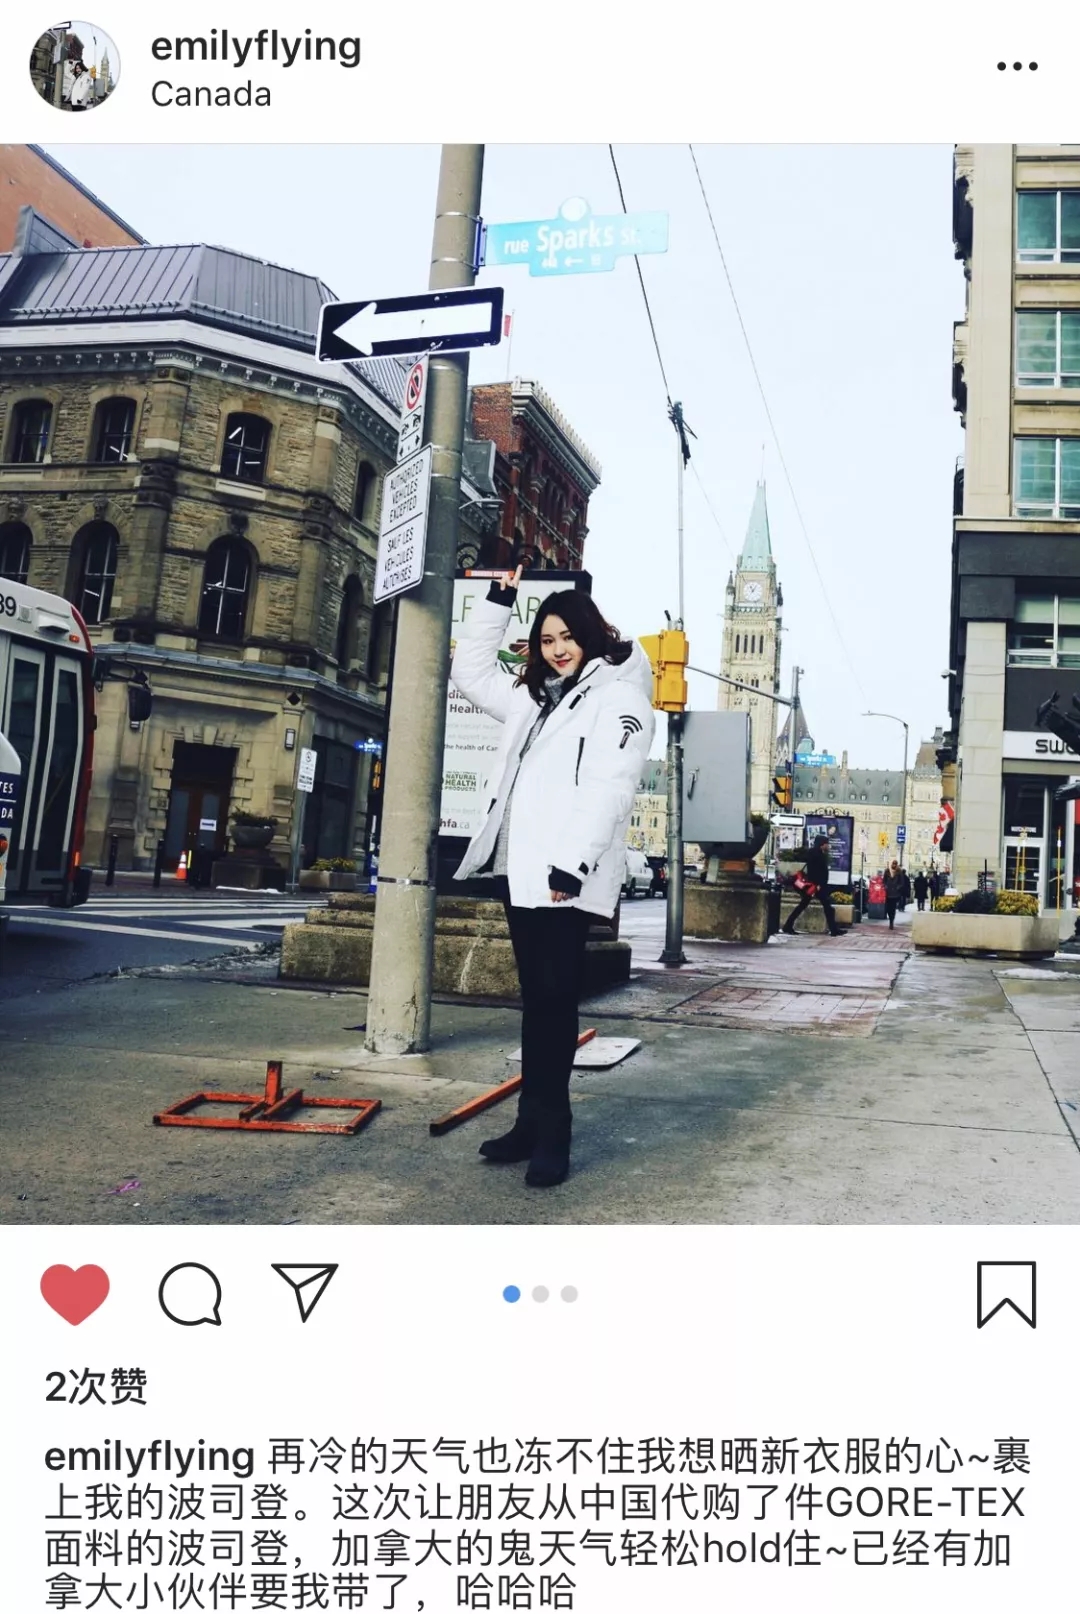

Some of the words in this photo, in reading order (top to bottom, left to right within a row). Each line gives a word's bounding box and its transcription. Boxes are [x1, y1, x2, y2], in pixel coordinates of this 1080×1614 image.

[504, 238, 529, 255] rue
[536, 219, 614, 259] Sparks
[389, 458, 424, 491] AUTHORIZED
[392, 478, 418, 505] VEHICLES
[389, 495, 418, 523] EXCEPTED
[402, 526, 414, 545] LES
[445, 773, 477, 781] NATURAL
[445, 779, 477, 787] HEALTH
[1, 807, 14, 819] DA
